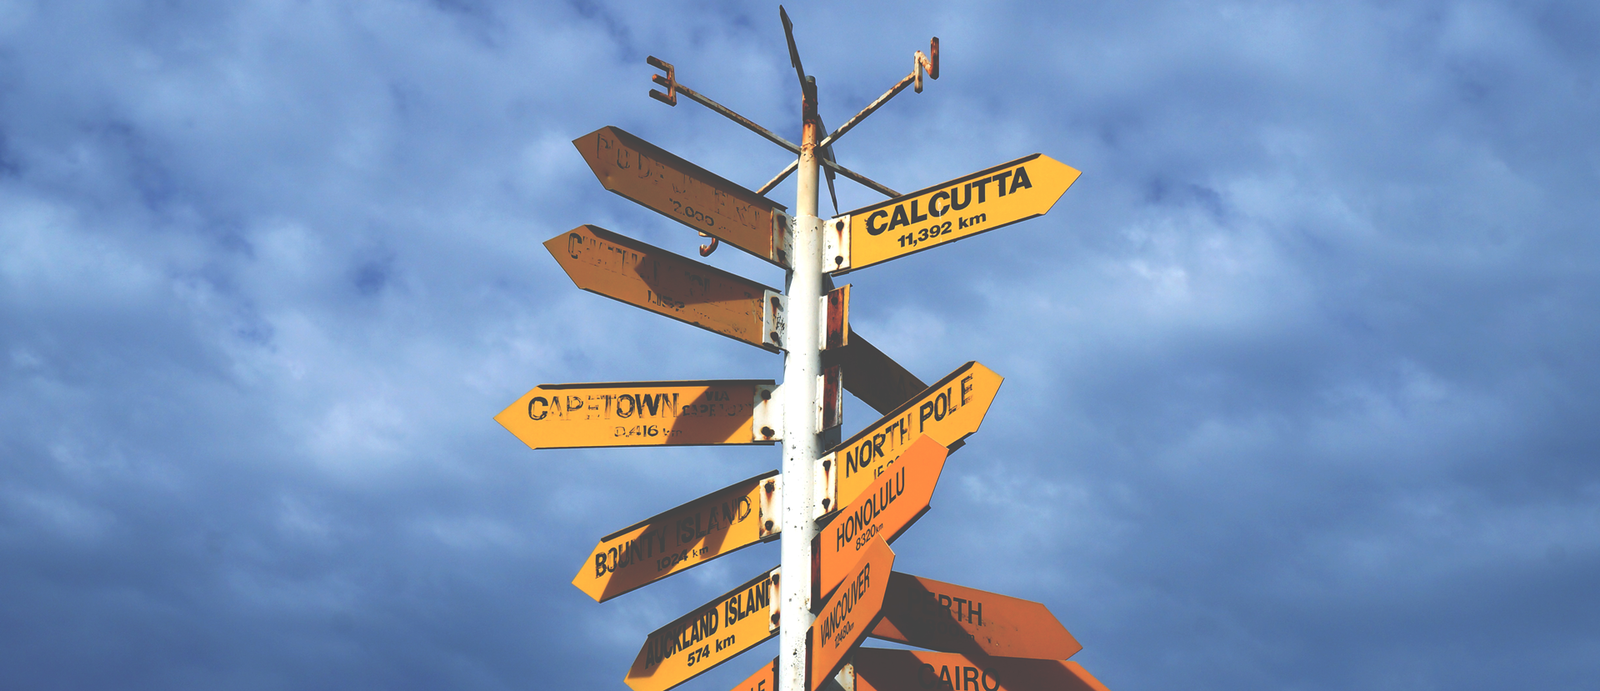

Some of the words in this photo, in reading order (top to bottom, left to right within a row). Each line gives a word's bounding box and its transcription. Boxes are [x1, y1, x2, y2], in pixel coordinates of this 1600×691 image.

[864, 166, 1033, 236] CALCUTTA
[897, 221, 952, 248] 11,392
[958, 212, 987, 230] km
[846, 412, 913, 479] NORTH
[919, 373, 974, 433] POLE
[595, 525, 671, 579] BOUNTY
[676, 495, 752, 547] ISLAND
[836, 466, 905, 552] HONOLULU
[657, 549, 689, 572] 1024
[692, 545, 709, 559] km
[821, 562, 871, 648] VANCOUVER
[645, 607, 719, 670] AUCKLAND
[687, 644, 710, 667] 574
[715, 634, 736, 653] km
[918, 663, 1001, 691] CAIRO
